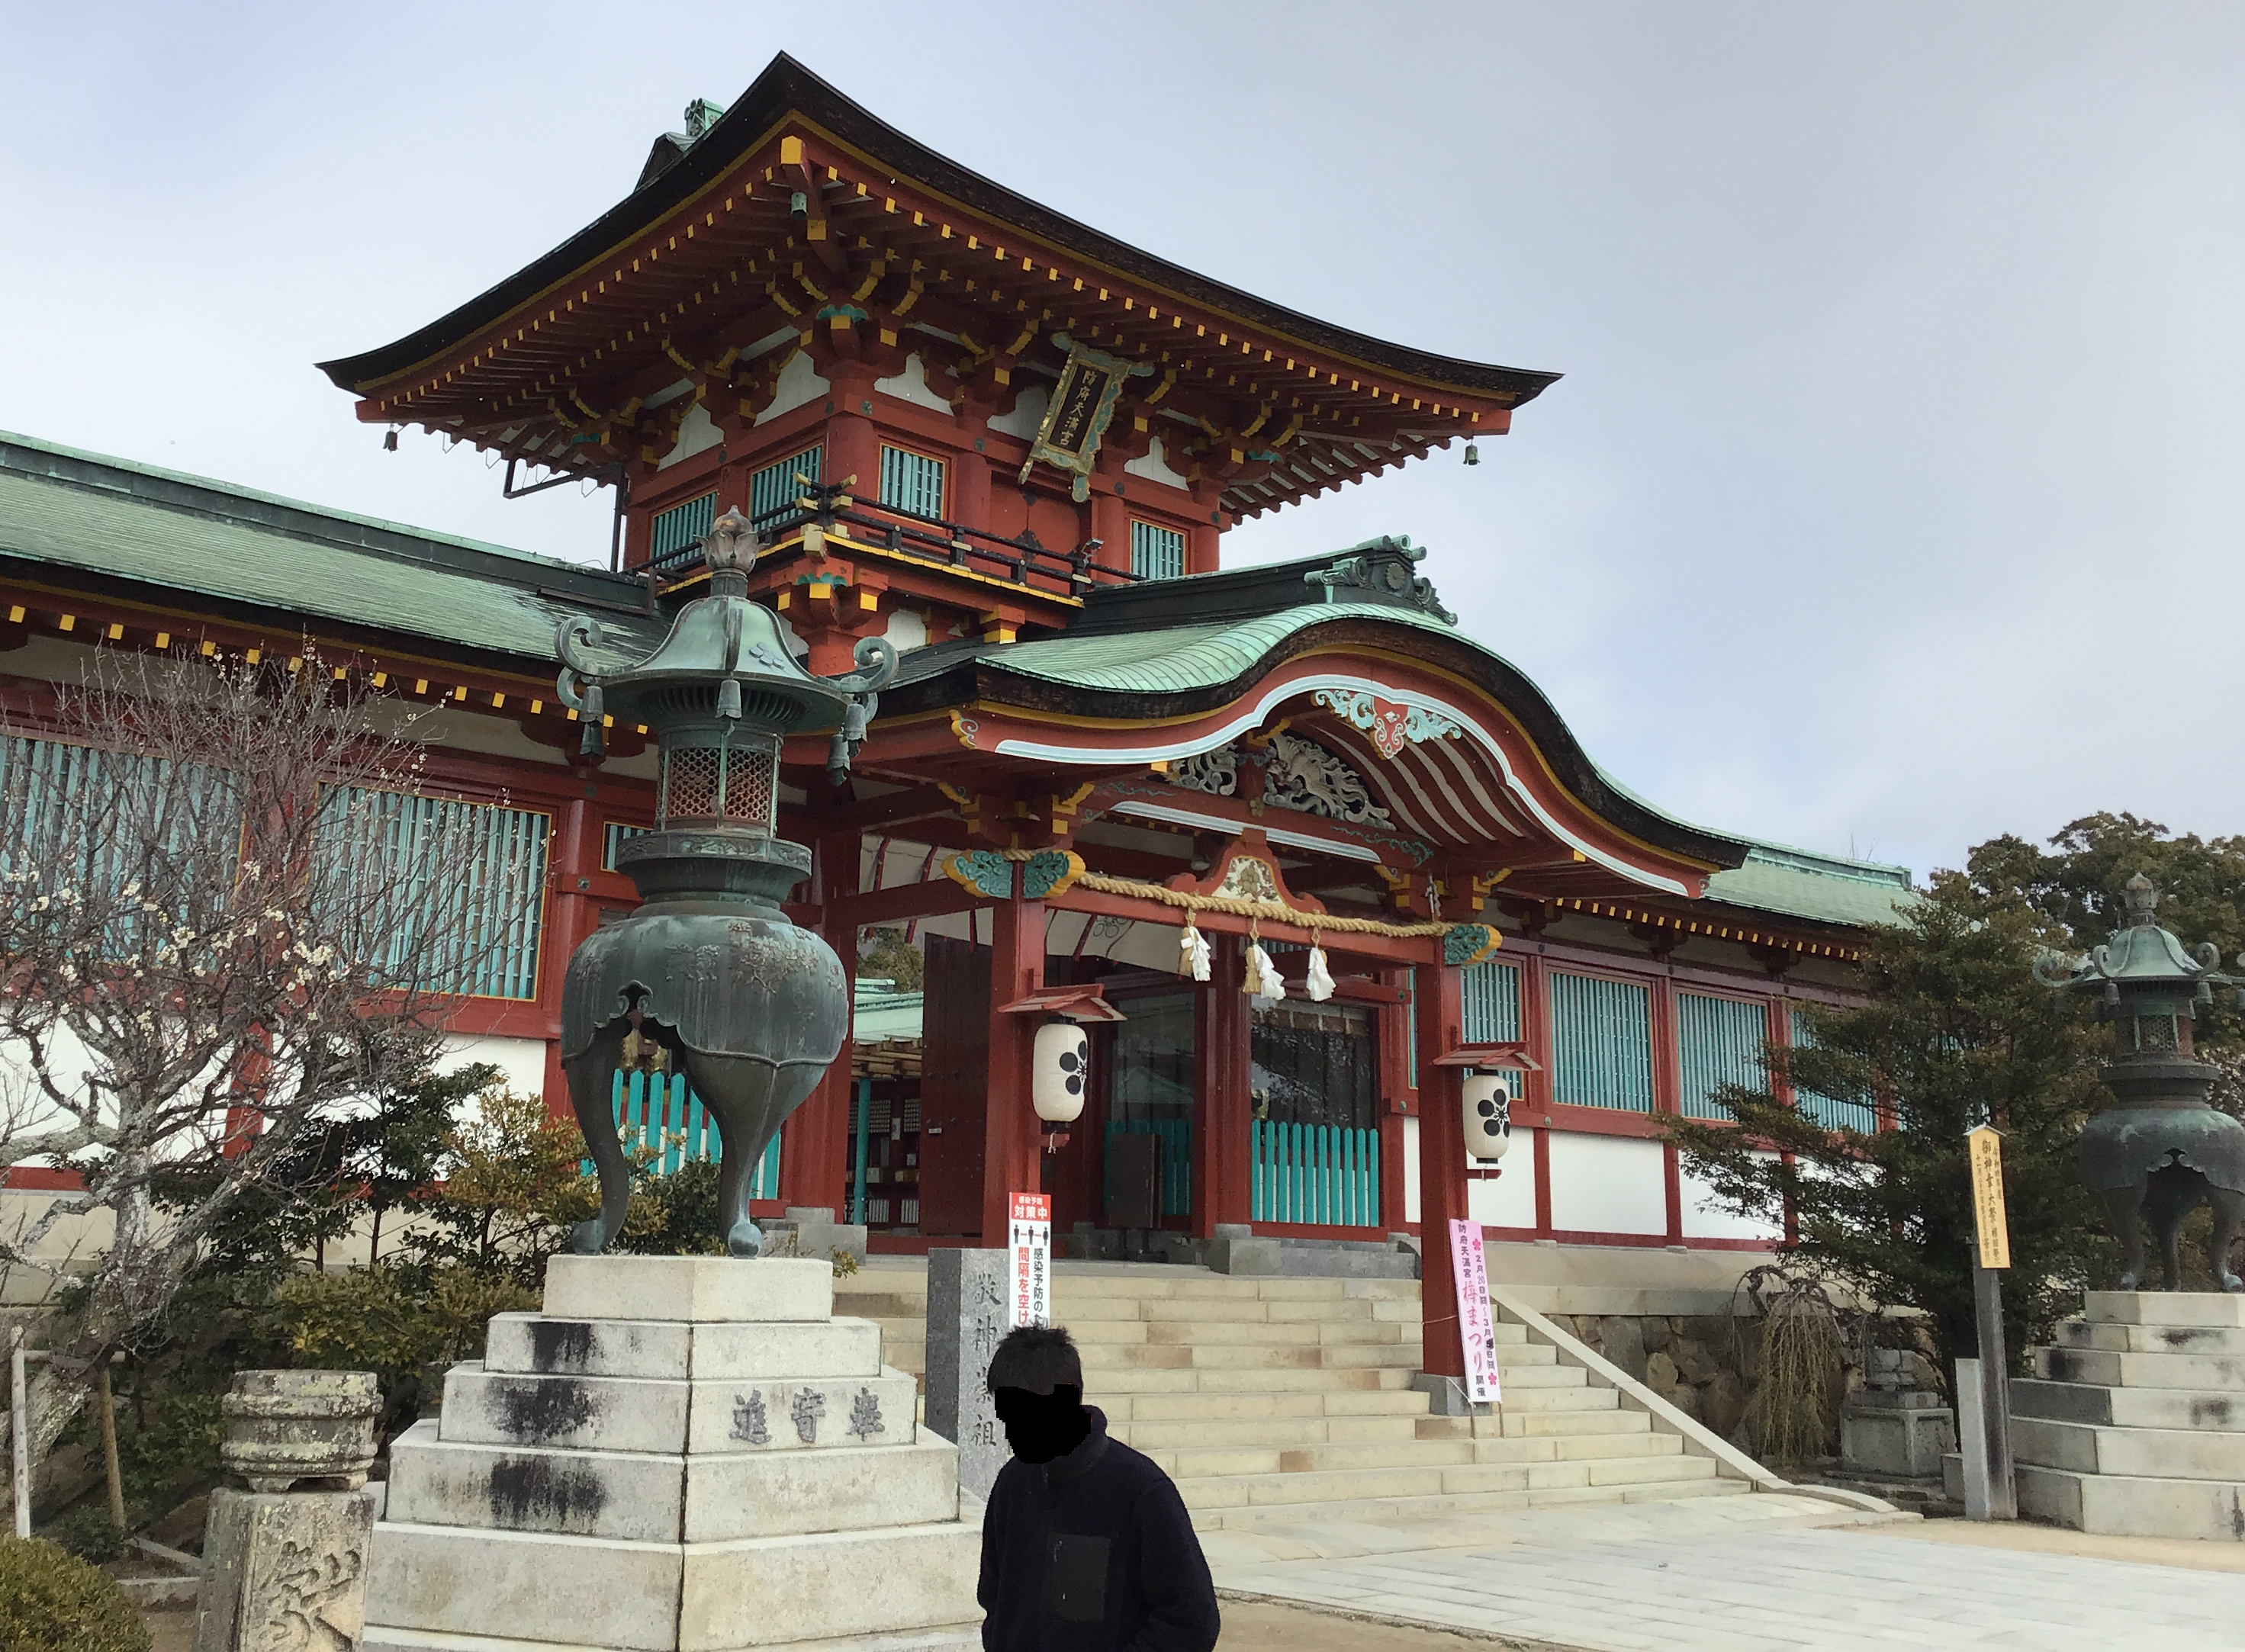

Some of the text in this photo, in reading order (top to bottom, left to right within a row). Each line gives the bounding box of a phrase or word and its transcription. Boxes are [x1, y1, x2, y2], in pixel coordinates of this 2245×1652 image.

[1018, 1195, 1043, 1206] 感染予防
[1014, 1204, 1048, 1220] 対策中
[1018, 1246, 1030, 1325] 間隔を空け
